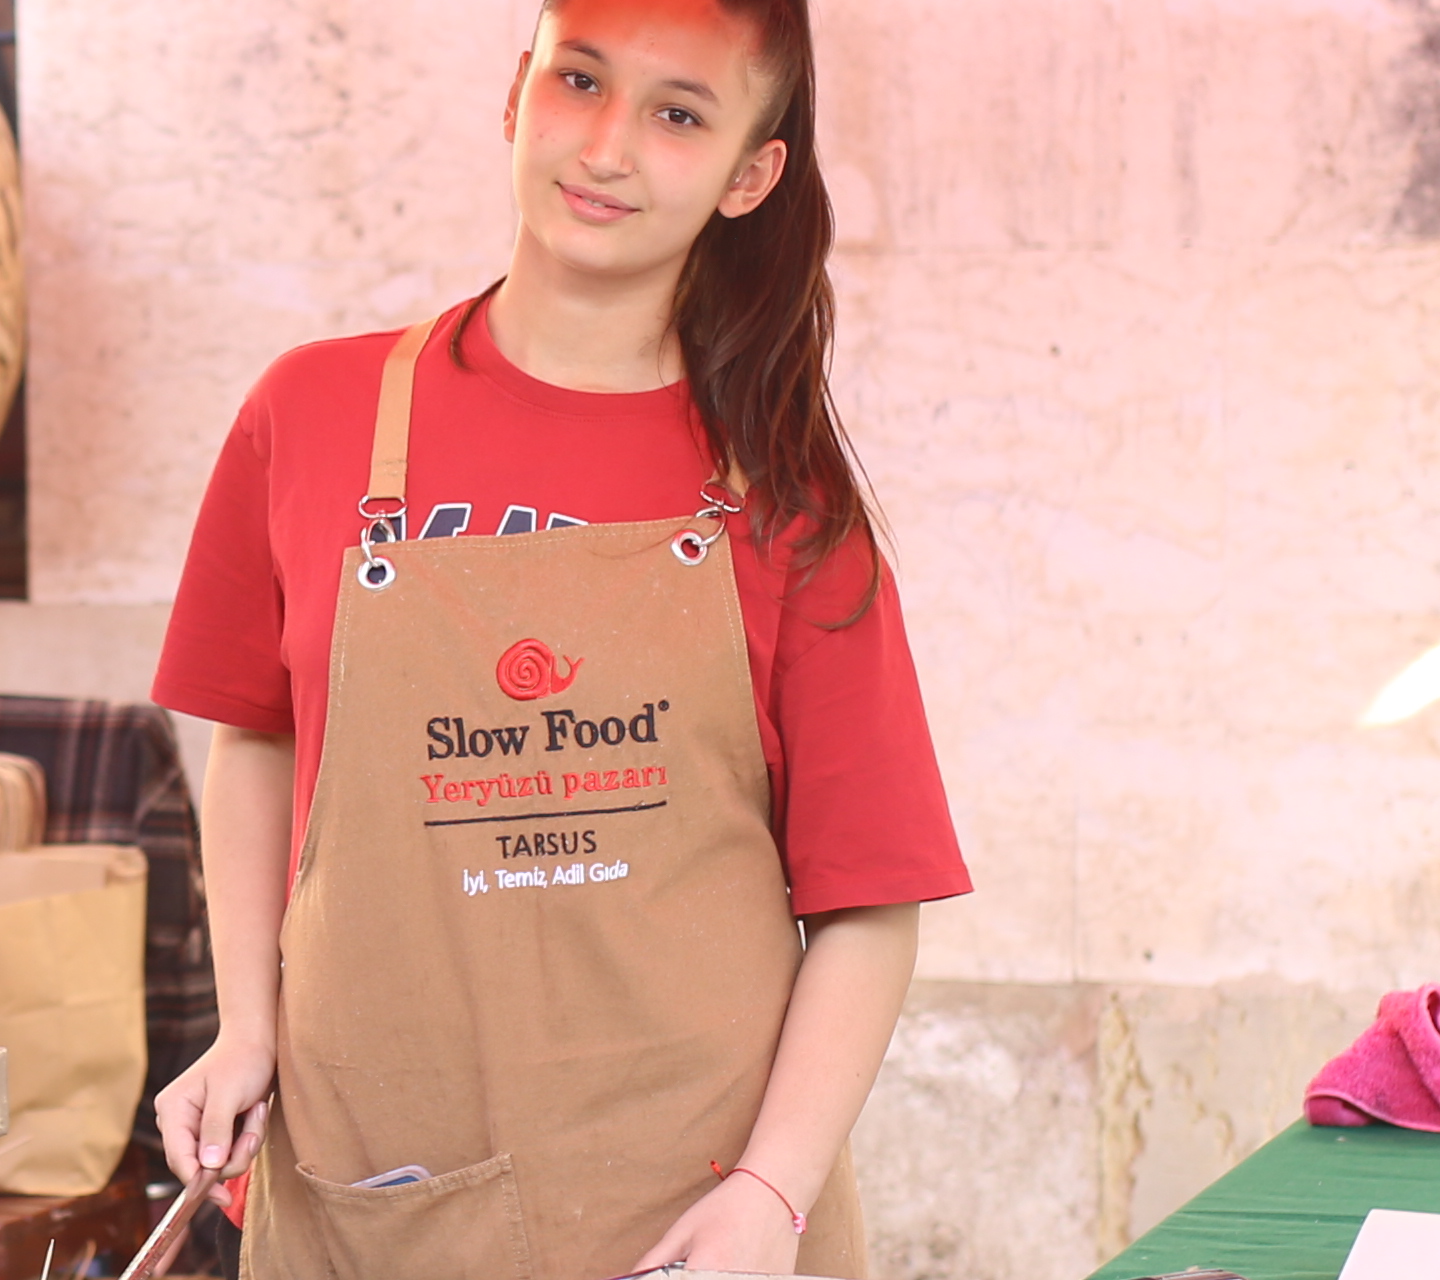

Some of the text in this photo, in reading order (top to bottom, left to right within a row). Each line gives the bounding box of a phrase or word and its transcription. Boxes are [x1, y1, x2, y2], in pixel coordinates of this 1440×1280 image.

[427, 717, 530, 760] Slow
[420, 766, 668, 806] Yeryüzü pazarı
[496, 830, 597, 859] TARSUS
[552, 863, 585, 886] Adil
